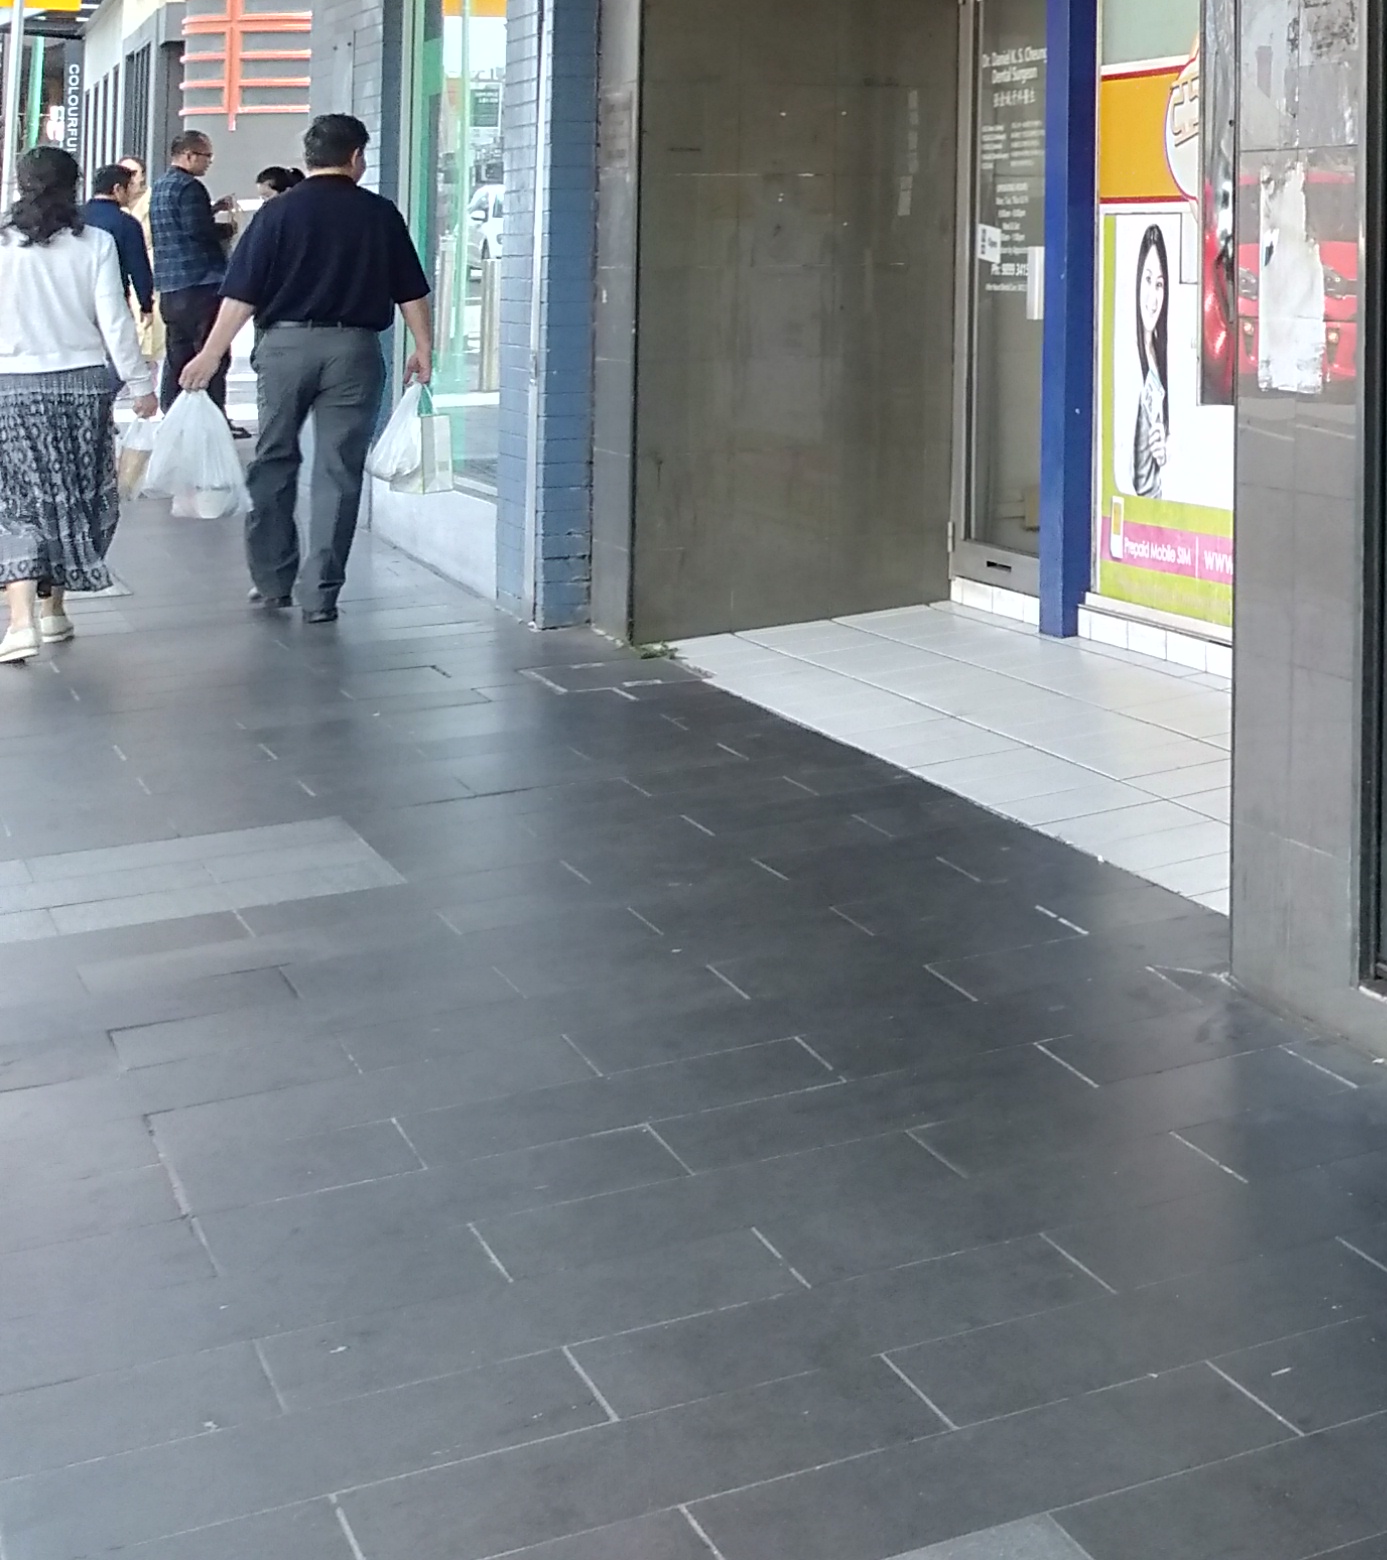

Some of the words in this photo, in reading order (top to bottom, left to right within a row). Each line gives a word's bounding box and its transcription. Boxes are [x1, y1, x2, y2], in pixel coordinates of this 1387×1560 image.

[1124, 537, 1149, 560] Prepaid
[1150, 542, 1176, 563] Mobile
[1176, 545, 1192, 566] SIM
